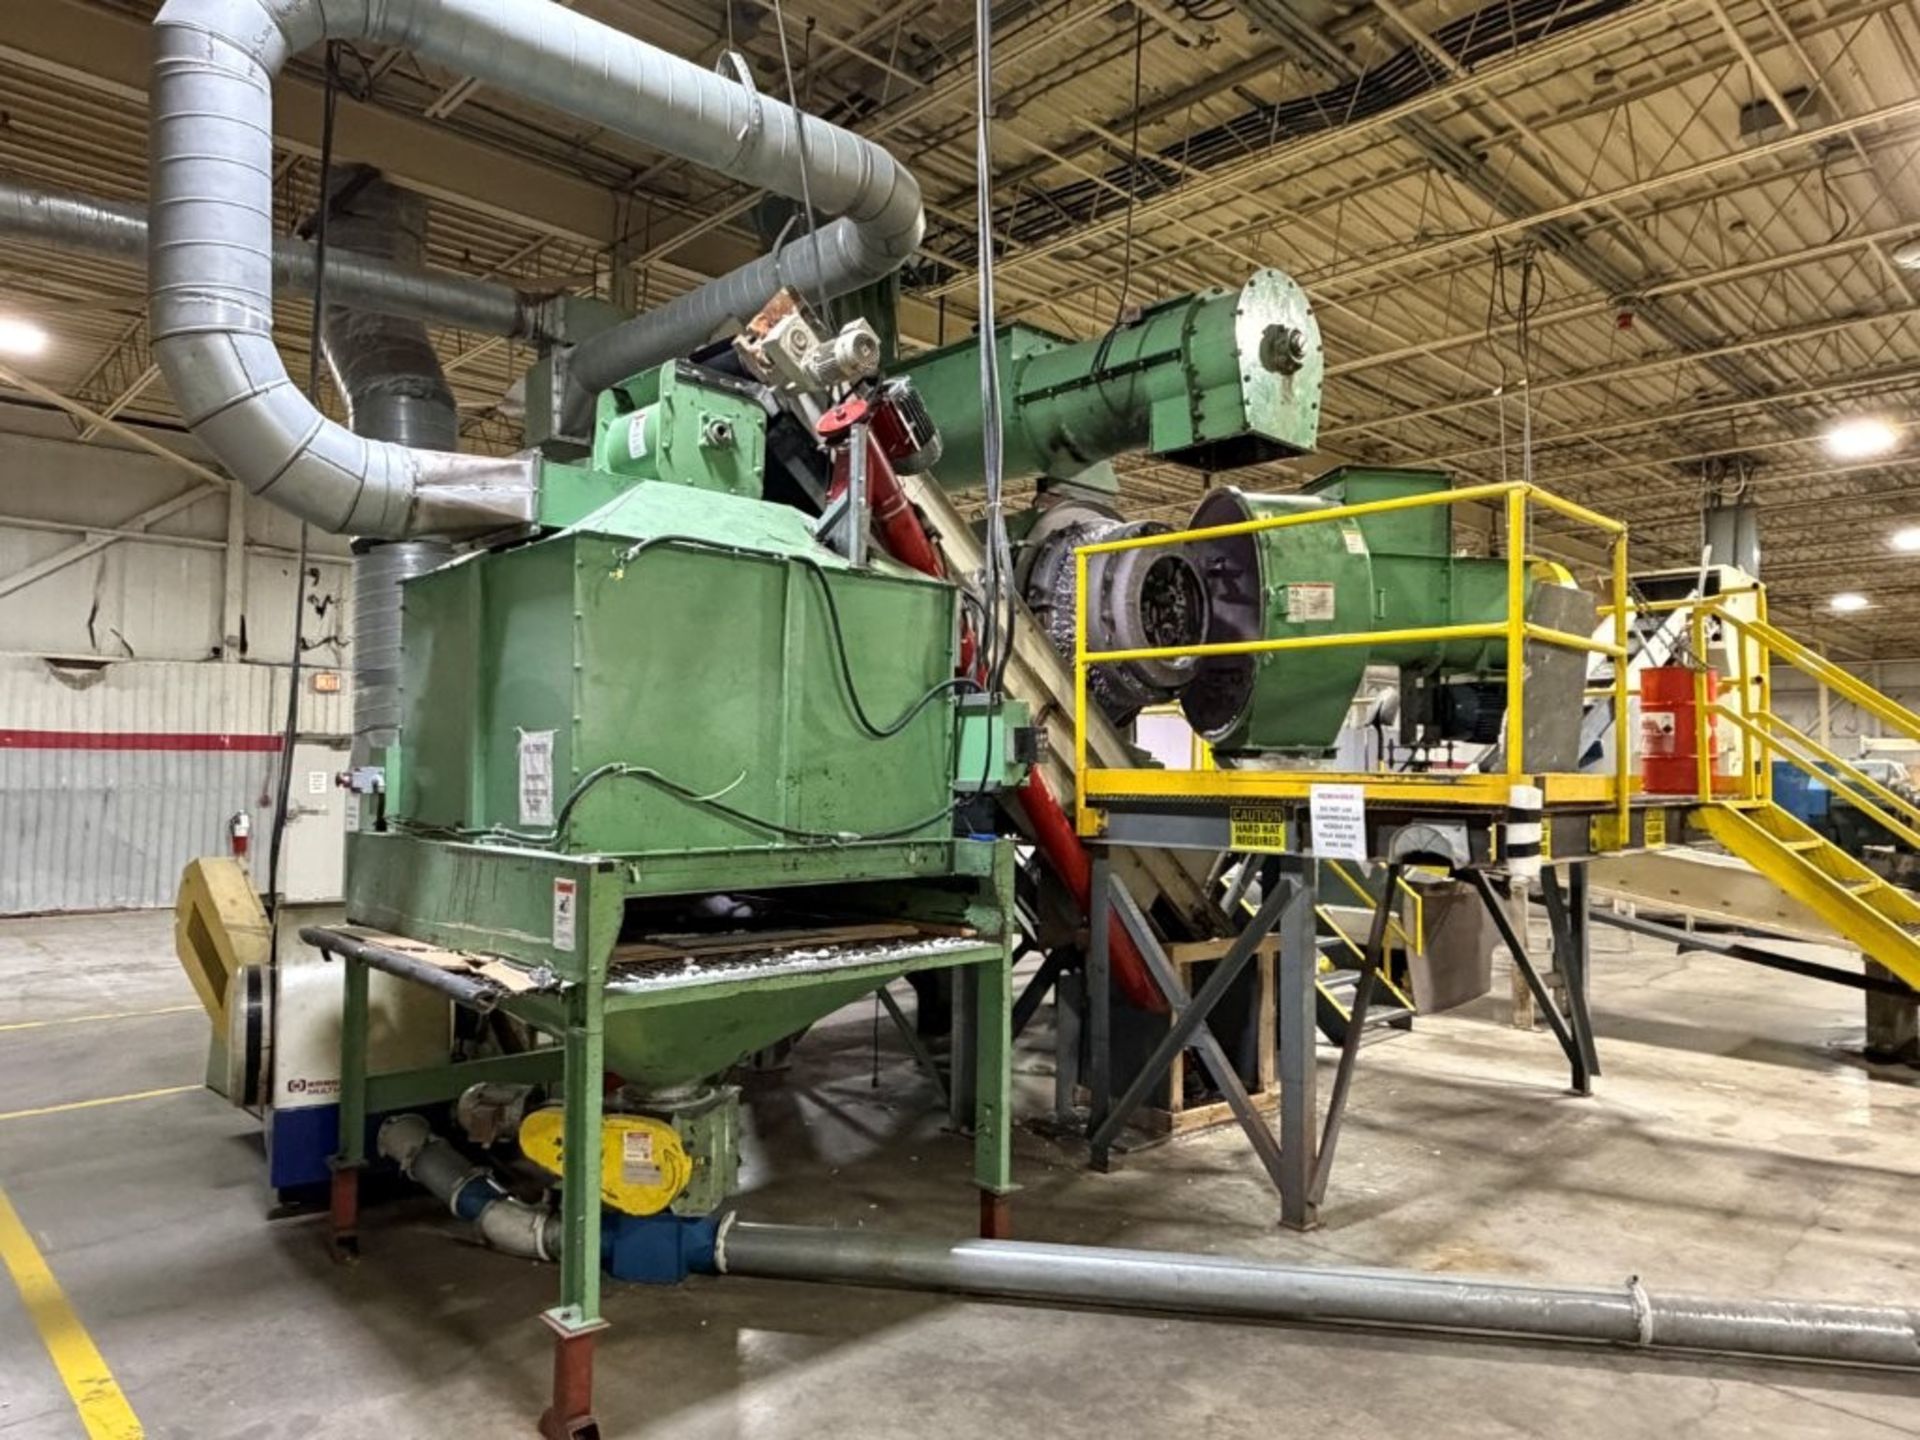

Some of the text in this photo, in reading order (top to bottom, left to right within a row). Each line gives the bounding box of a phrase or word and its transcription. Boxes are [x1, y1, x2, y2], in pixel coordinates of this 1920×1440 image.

[1233, 809, 1281, 822] CAUTION
[1235, 824, 1280, 835] HARD HAT
[1235, 835, 1281, 846] REQUIRED
